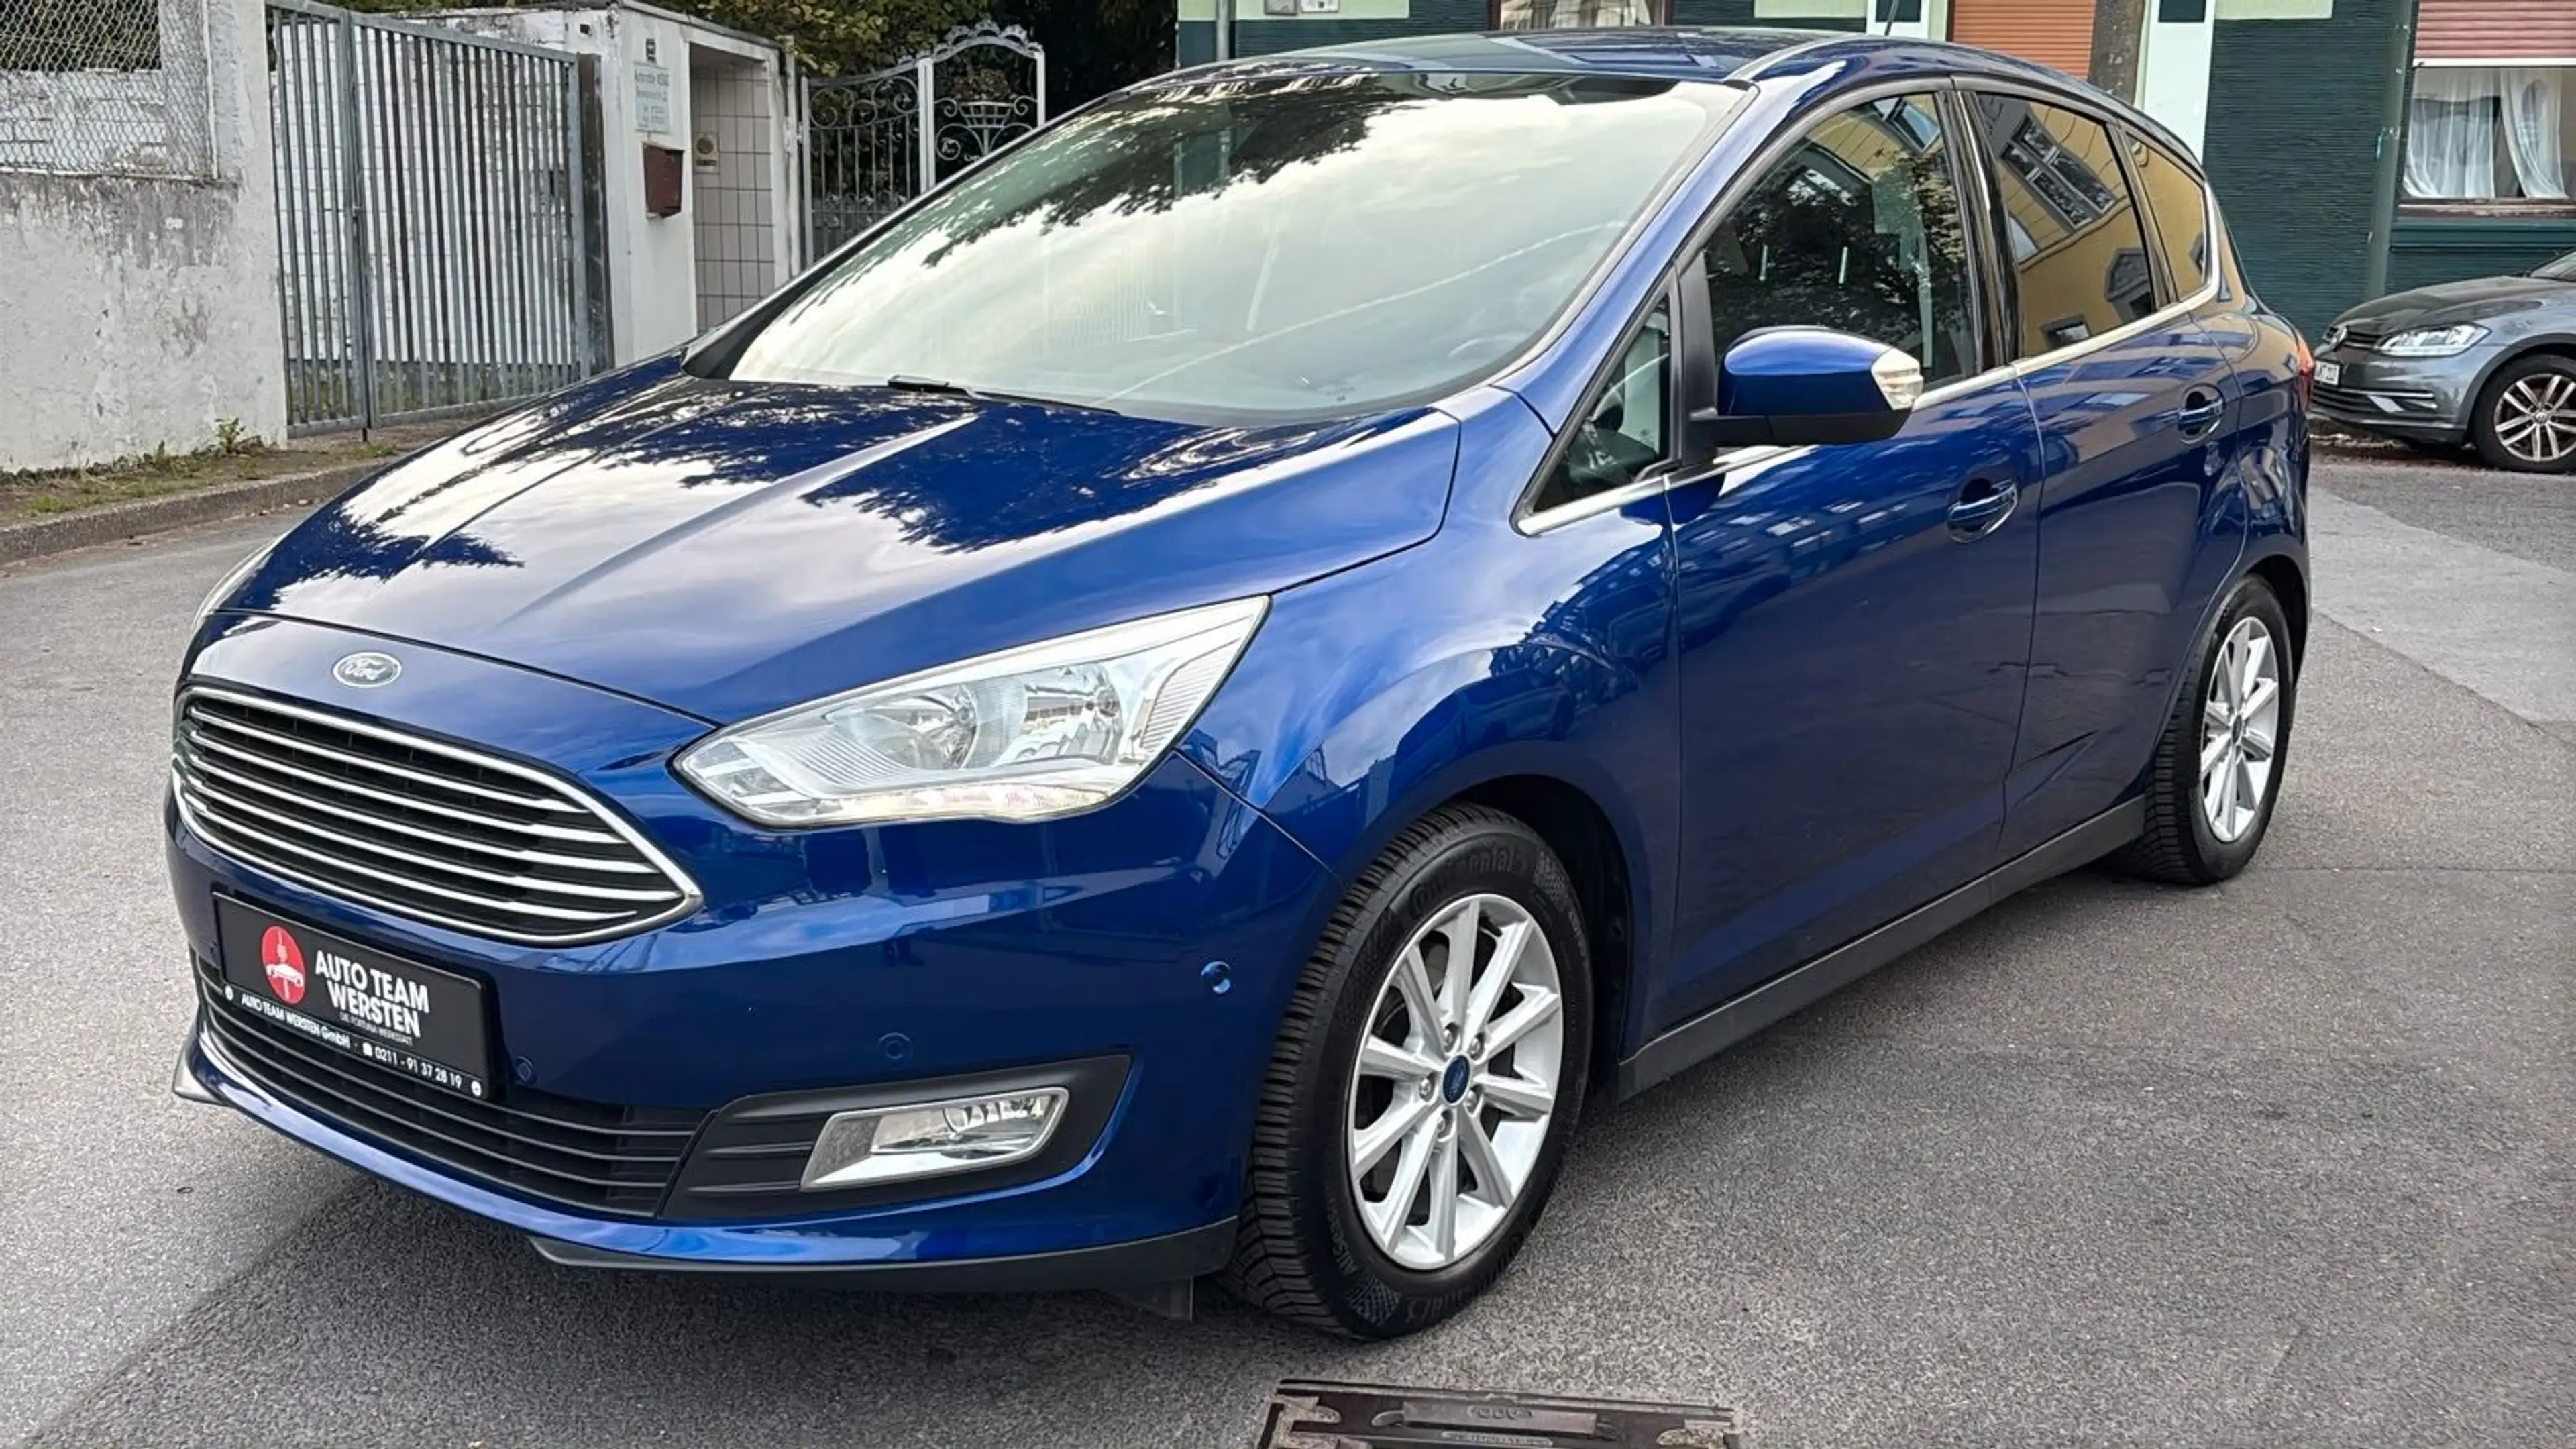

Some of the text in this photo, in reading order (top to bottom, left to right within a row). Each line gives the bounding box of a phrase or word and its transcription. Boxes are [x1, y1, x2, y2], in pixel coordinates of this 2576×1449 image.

[315, 950, 429, 1014] AUTO TEAM
[327, 979, 421, 1038] WERSTEN
[241, 992, 262, 1012] AUTO
[262, 1001, 286, 1021] TEAM
[321, 1026, 350, 1049] GmbH
[375, 1046, 398, 1066] 0211
[406, 1057, 419, 1073] 91
[421, 1062, 433, 1077] 37
[435, 1067, 448, 1083] 28
[449, 1072, 462, 1089] 19
